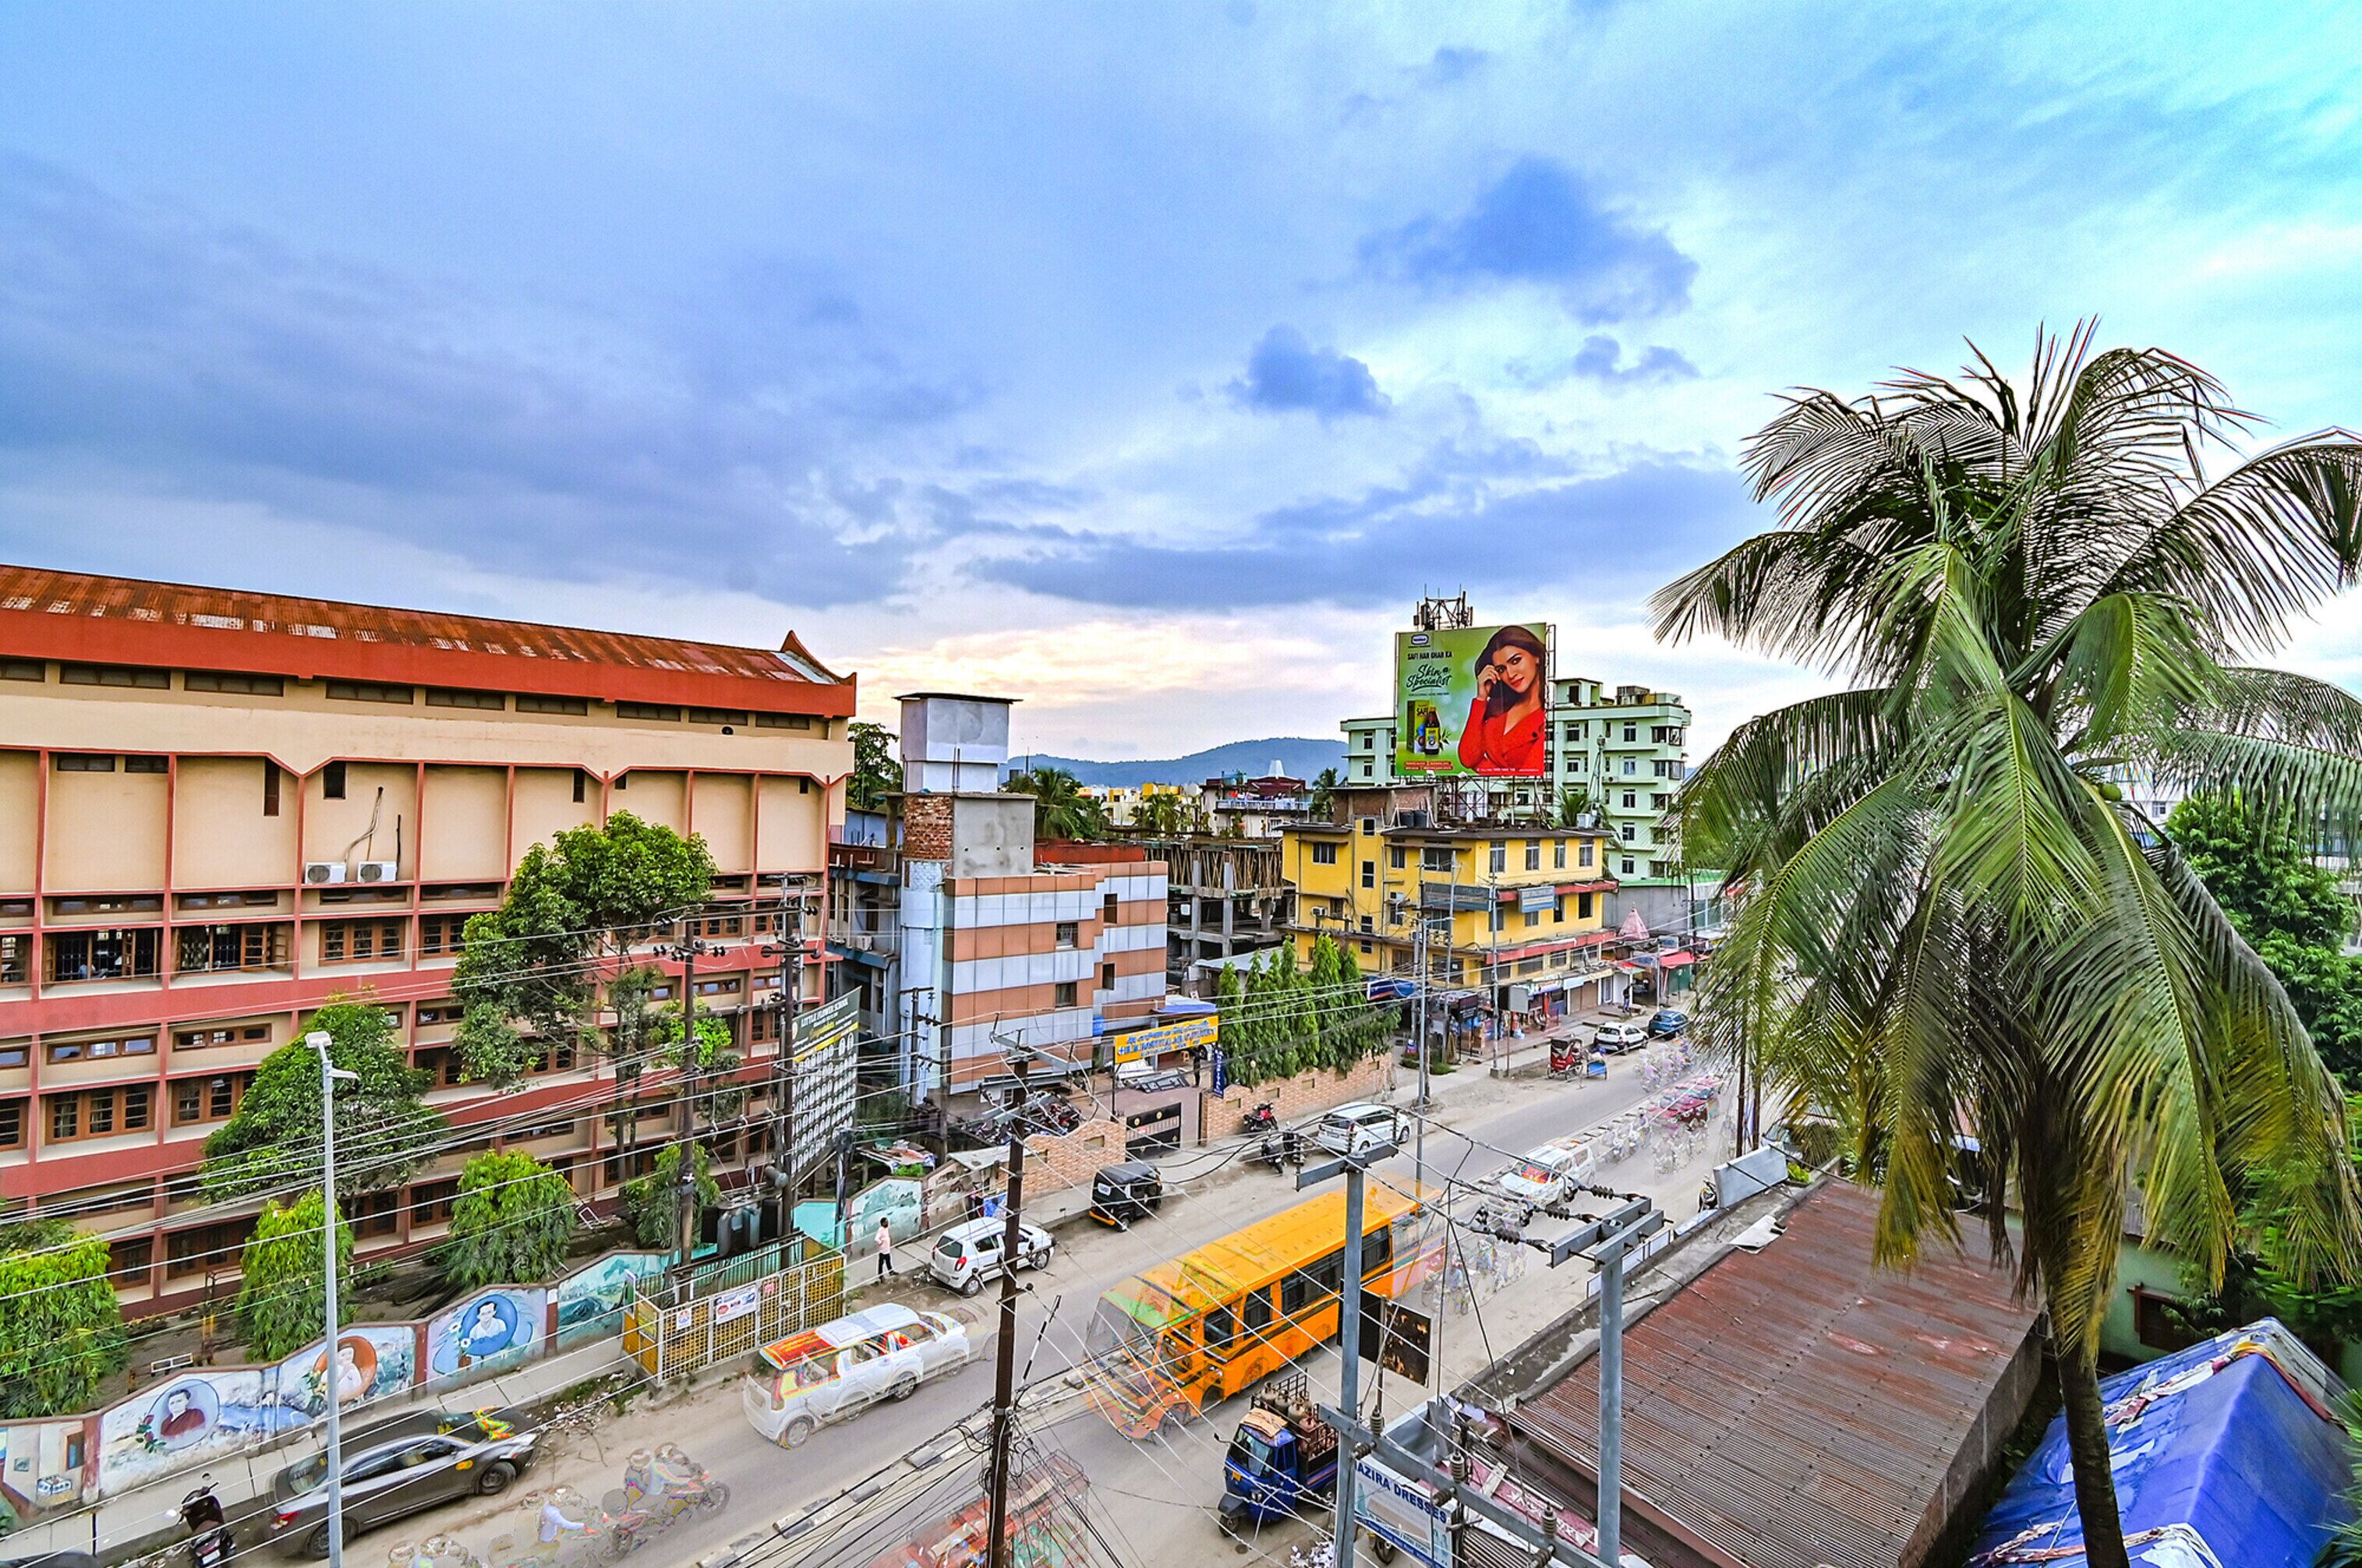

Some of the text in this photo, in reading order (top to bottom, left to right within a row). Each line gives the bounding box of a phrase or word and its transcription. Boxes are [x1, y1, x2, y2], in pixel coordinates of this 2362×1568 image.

[1417, 663, 1441, 680] Skin
[1406, 674, 1452, 688] Specialist
[801, 1013, 817, 1027] LITTLE
[1356, 1461, 1448, 1524] AZIRA DRESSES
